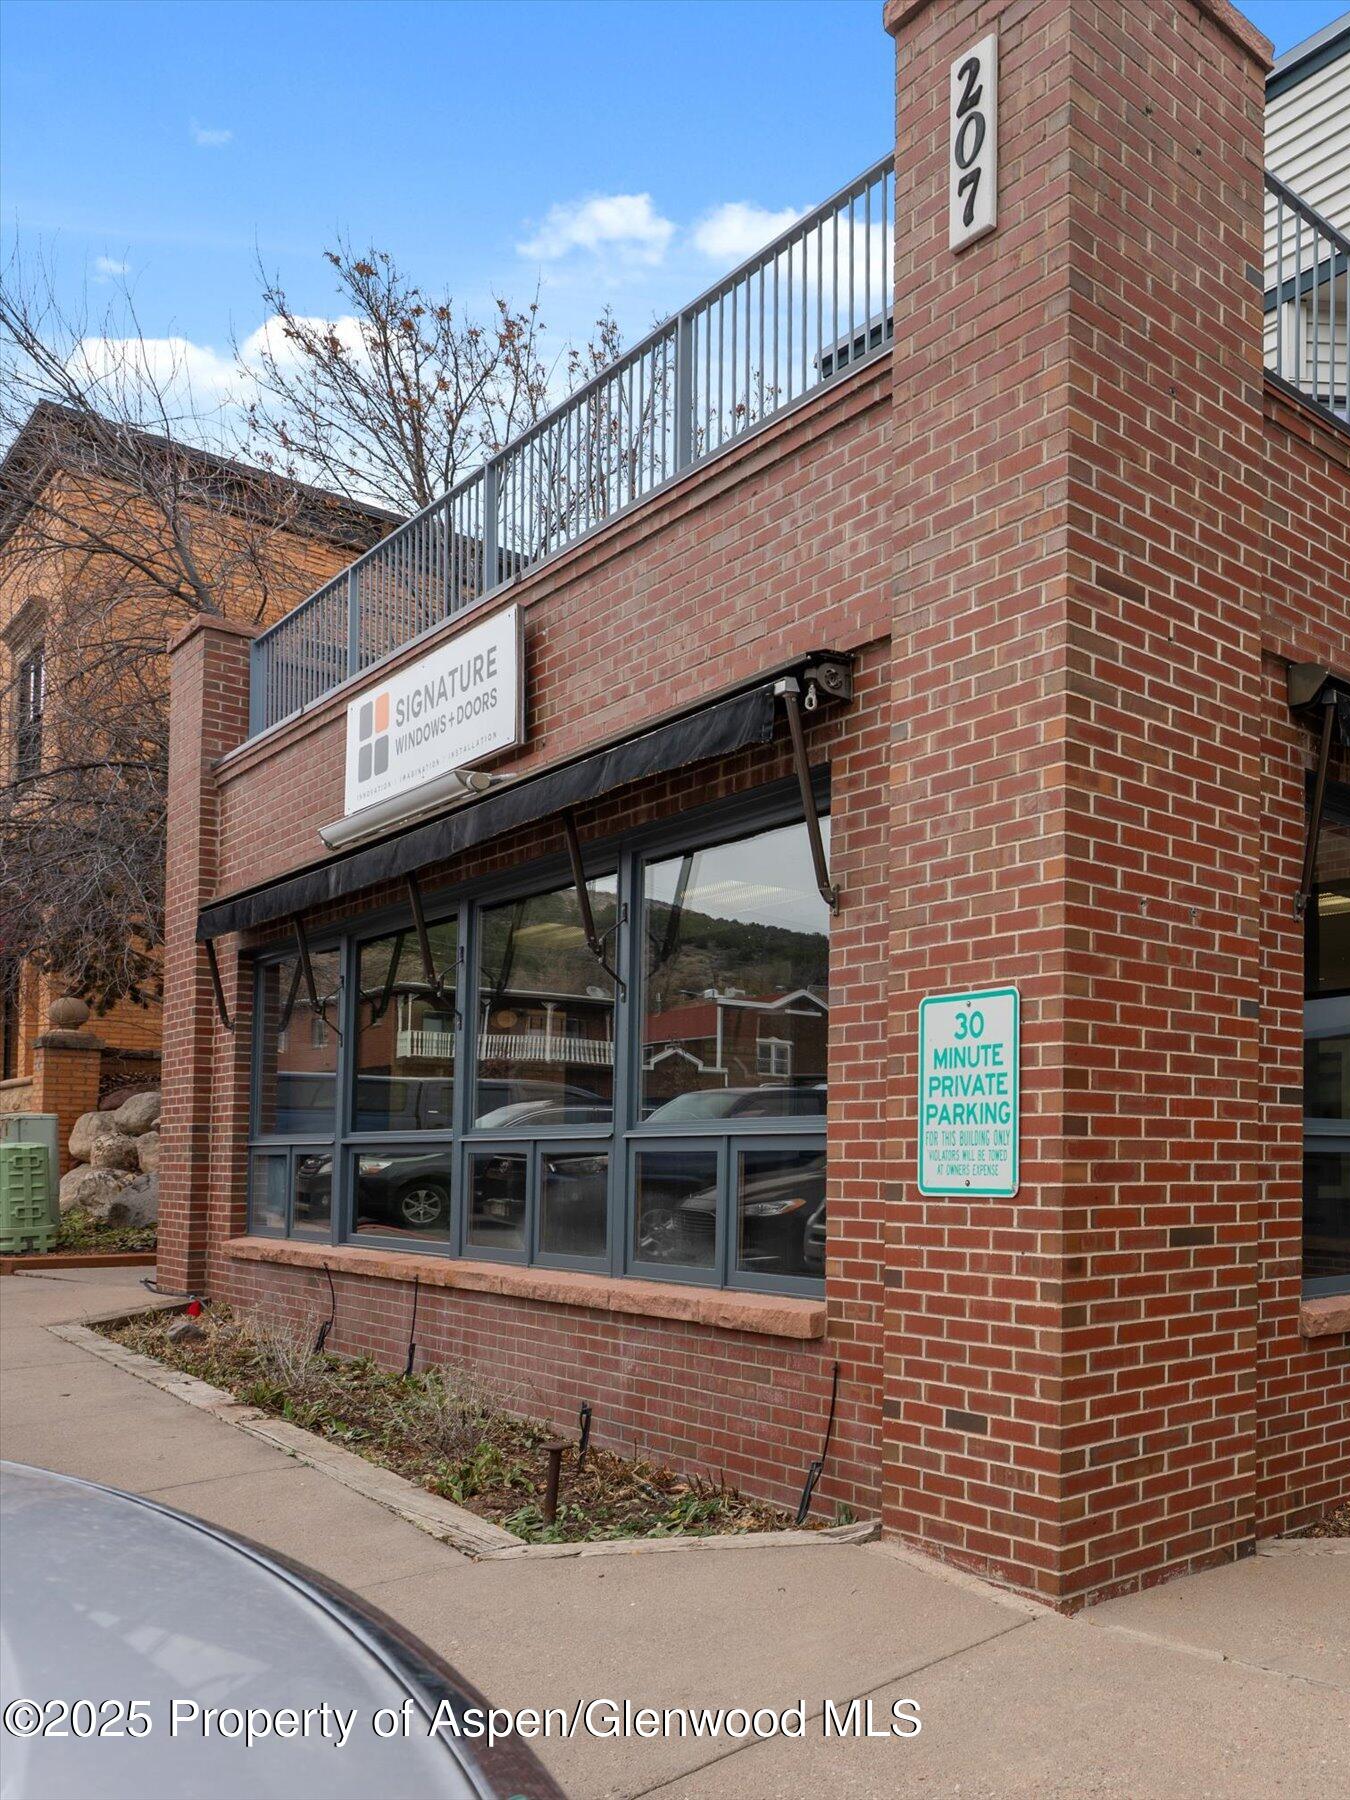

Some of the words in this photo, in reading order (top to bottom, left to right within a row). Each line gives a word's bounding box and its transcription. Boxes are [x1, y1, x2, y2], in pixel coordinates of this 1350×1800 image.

[956, 56, 986, 228] 207
[395, 645, 498, 728] SIGNATURE
[395, 714, 447, 756] WINDOWS
[456, 688, 498, 725] DOORS
[448, 731, 498, 760] INSTALLATION
[954, 1010, 985, 1040] 30
[933, 1043, 1004, 1070] MINUTE
[928, 1072, 1008, 1098] PRIVATE
[926, 1101, 1011, 1126] PARKING
[926, 1131, 939, 1147] FOR
[942, 1130, 956, 1147] THIS
[960, 1129, 990, 1146] BUILDING
[993, 1129, 1010, 1146] ONLY
[928, 1150, 959, 1161] VIOLATORS
[962, 1150, 975, 1161] WILL
[978, 1150, 985, 1161] BE
[988, 1149, 1007, 1161] TOWED
[937, 1164, 944, 1176] AT
[972, 1164, 999, 1176] EXPENSE
